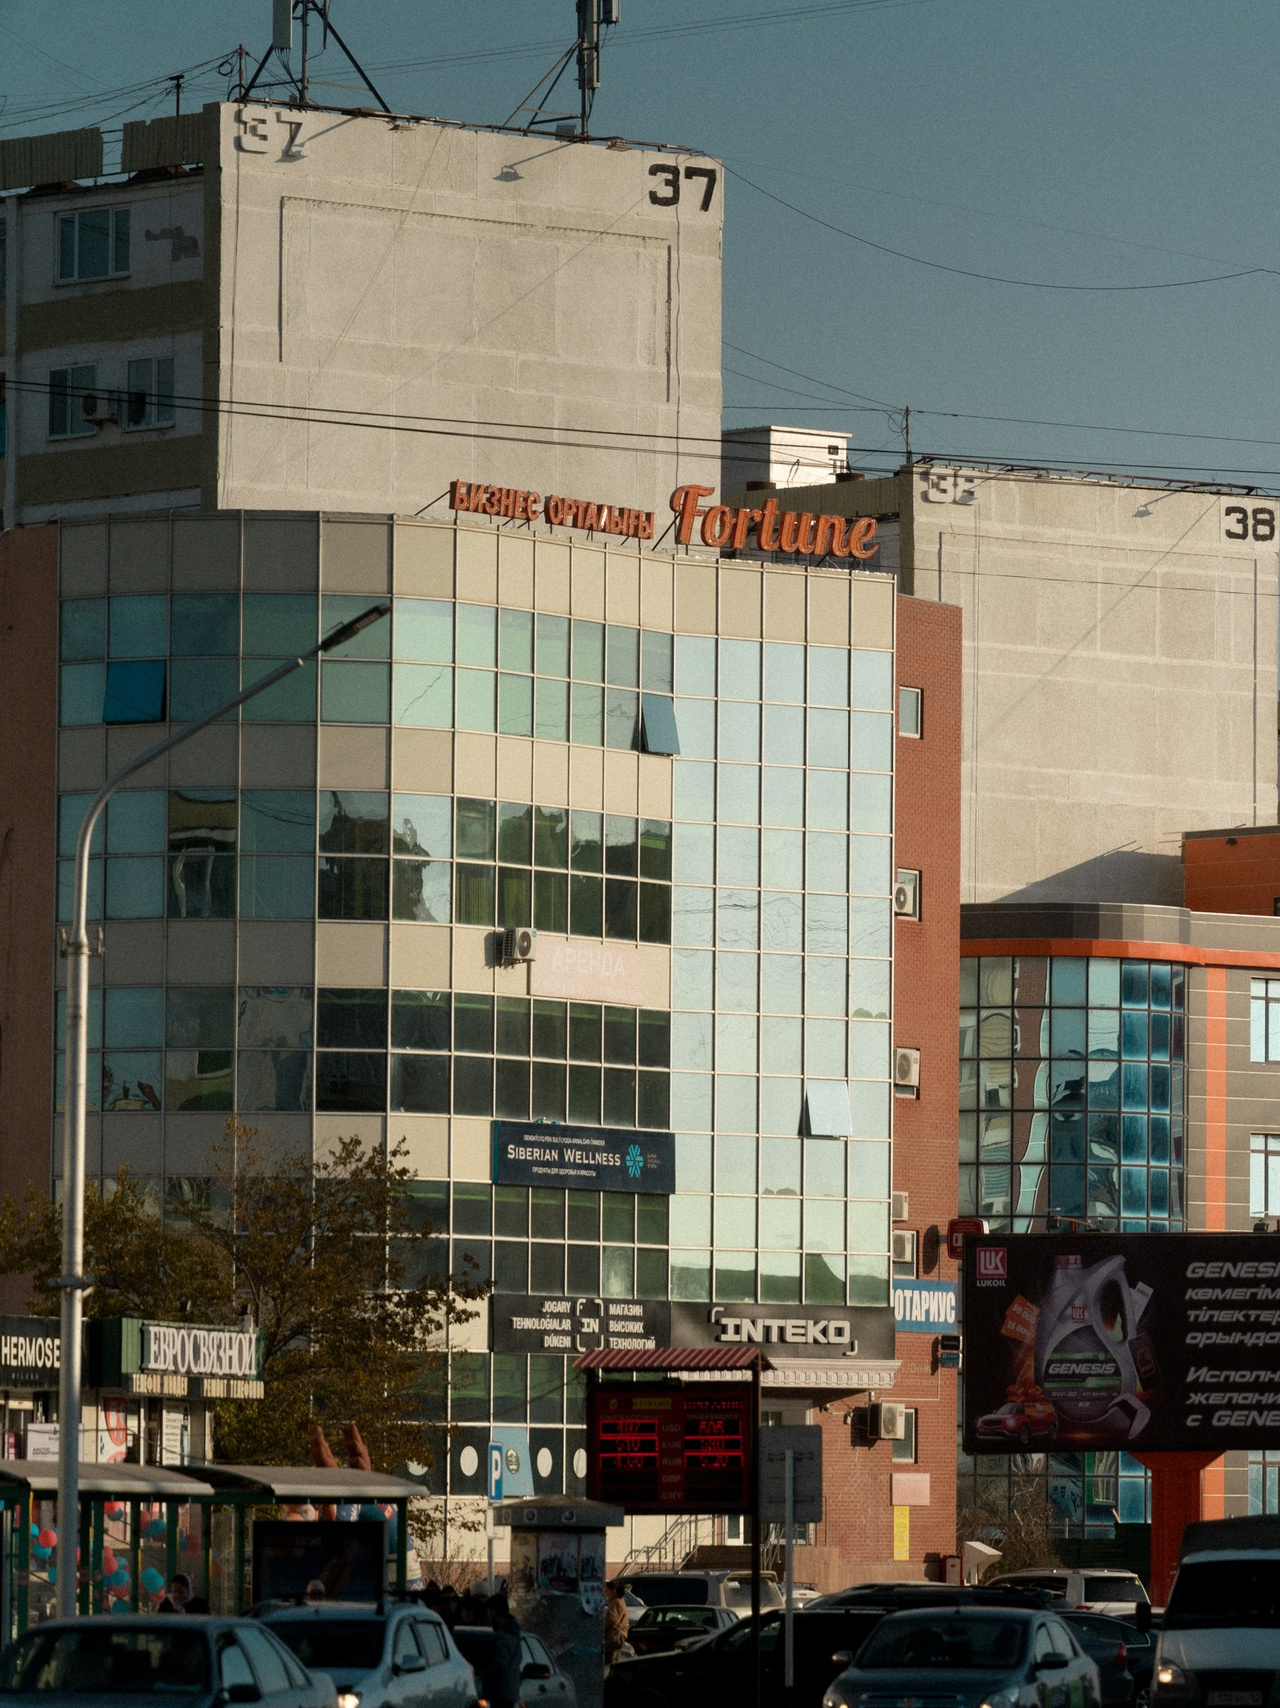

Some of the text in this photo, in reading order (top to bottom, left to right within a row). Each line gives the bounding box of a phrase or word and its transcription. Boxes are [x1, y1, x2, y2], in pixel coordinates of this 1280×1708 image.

[648, 163, 717, 212] 37
[449, 480, 655, 540] БИЗНЕС ОРТАЛЫҒЫ
[670, 484, 880, 559] Fortune
[1225, 506, 1275, 541] 38
[507, 1144, 621, 1166] SIBERIAN WELLNESS
[542, 1301, 572, 1314] JOGARY
[609, 1304, 643, 1317] МАГАЗИН
[581, 1318, 599, 1333] IN
[609, 1320, 645, 1334] ВЫСОКИХ
[720, 1317, 851, 1344] INTEKO
[609, 1336, 656, 1350] ТЕХНОЛОГИЙ
[148, 1325, 257, 1376] ЕВРОСВЯЗНОЙ
[1048, 1363, 1116, 1374] GENESIS
[662, 1423, 682, 1432] USD
[662, 1441, 682, 1449] EUR
[662, 1457, 682, 1466] RUB
[491, 1450, 502, 1497] P
[662, 1474, 682, 1483] GBP
[662, 1491, 682, 1500] CNY
